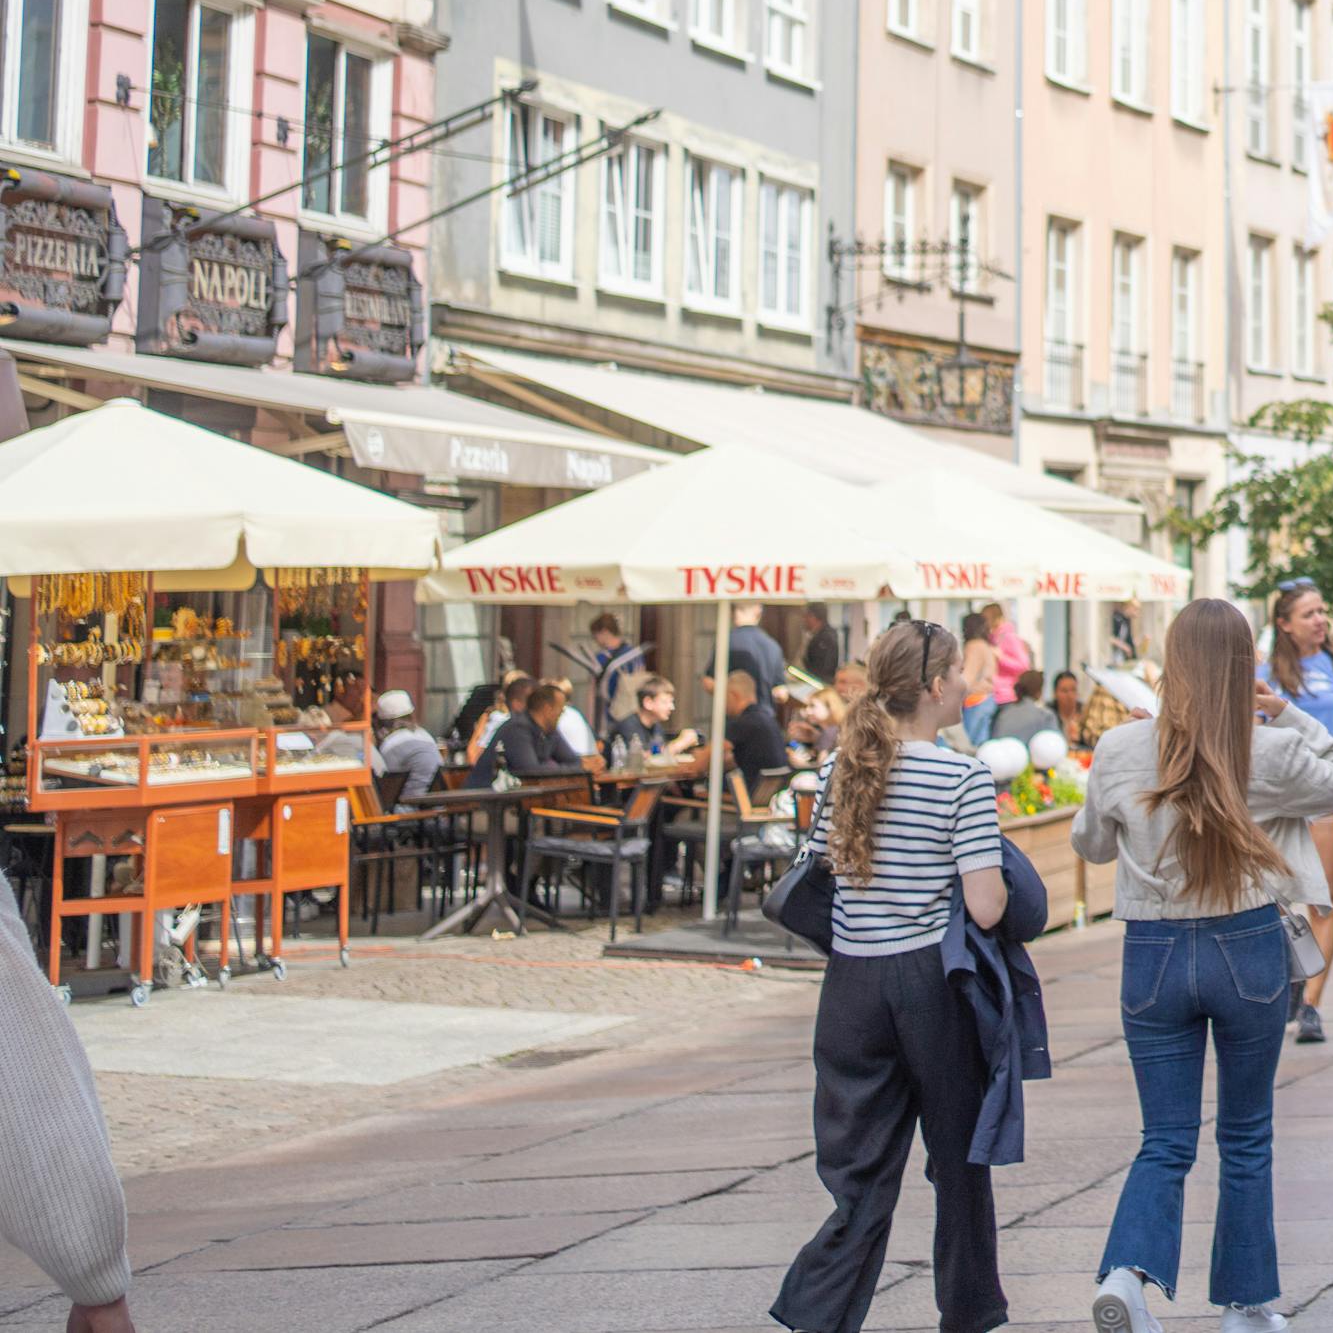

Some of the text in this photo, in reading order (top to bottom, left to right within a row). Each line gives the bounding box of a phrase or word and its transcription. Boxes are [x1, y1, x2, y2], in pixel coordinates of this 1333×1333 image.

[14, 232, 100, 278] PIZZERIA
[193, 258, 267, 310] NAPOLI
[449, 436, 613, 486] Pizzeria Napoli
[459, 565, 567, 595] TYSKIE
[678, 564, 807, 595] TYSKIE
[916, 561, 994, 592] TYSKIE
